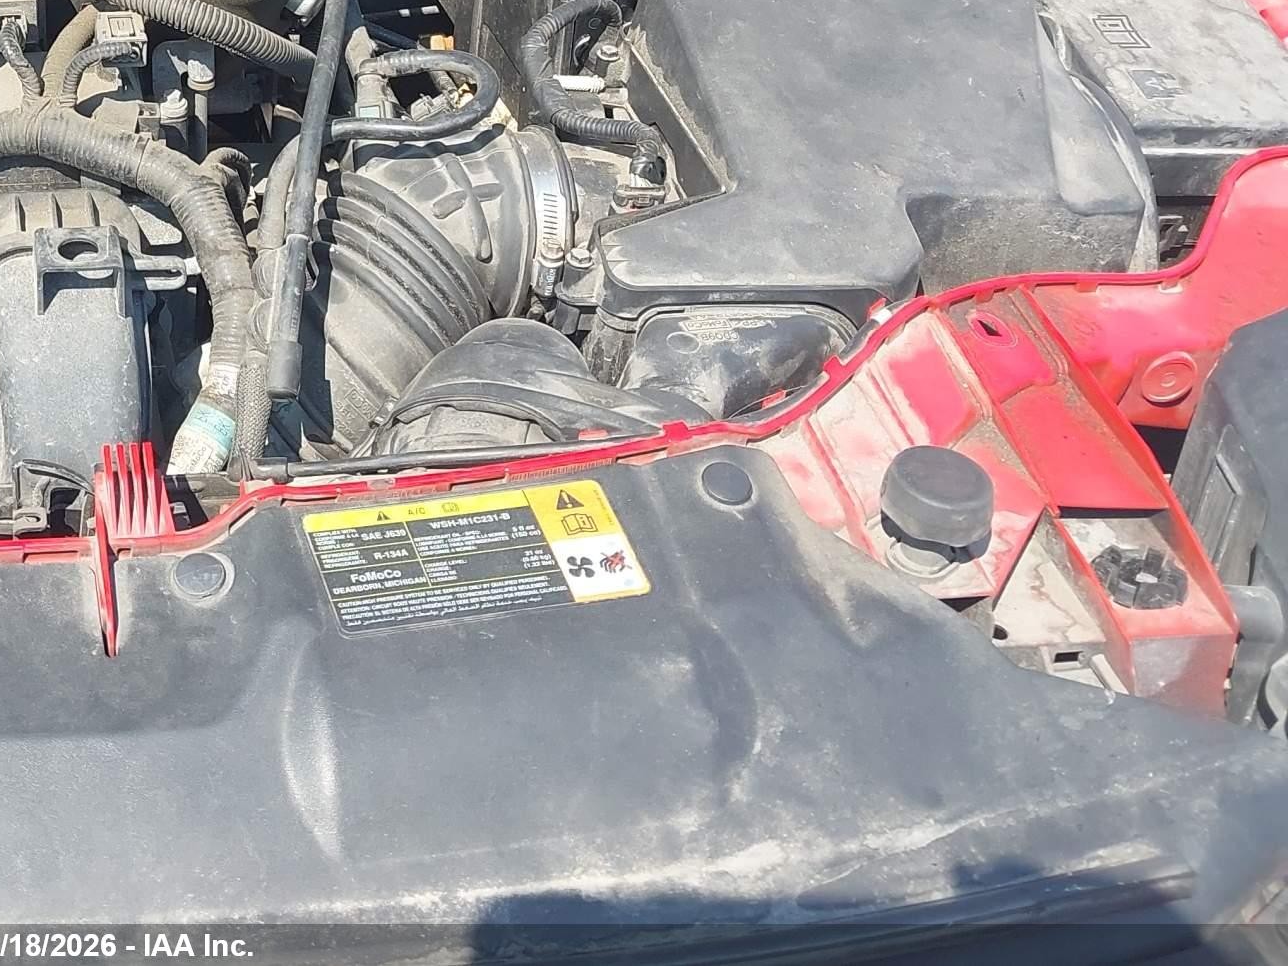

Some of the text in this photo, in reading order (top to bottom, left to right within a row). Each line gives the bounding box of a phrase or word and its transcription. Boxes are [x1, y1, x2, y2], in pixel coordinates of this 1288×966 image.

[407, 508, 426, 516] A/C
[361, 530, 407, 541] SAE J639
[373, 549, 409, 560] R-134A
[350, 568, 402, 584] FoMoCo
[333, 577, 426, 596] DEARBORN, MICHIGAN
